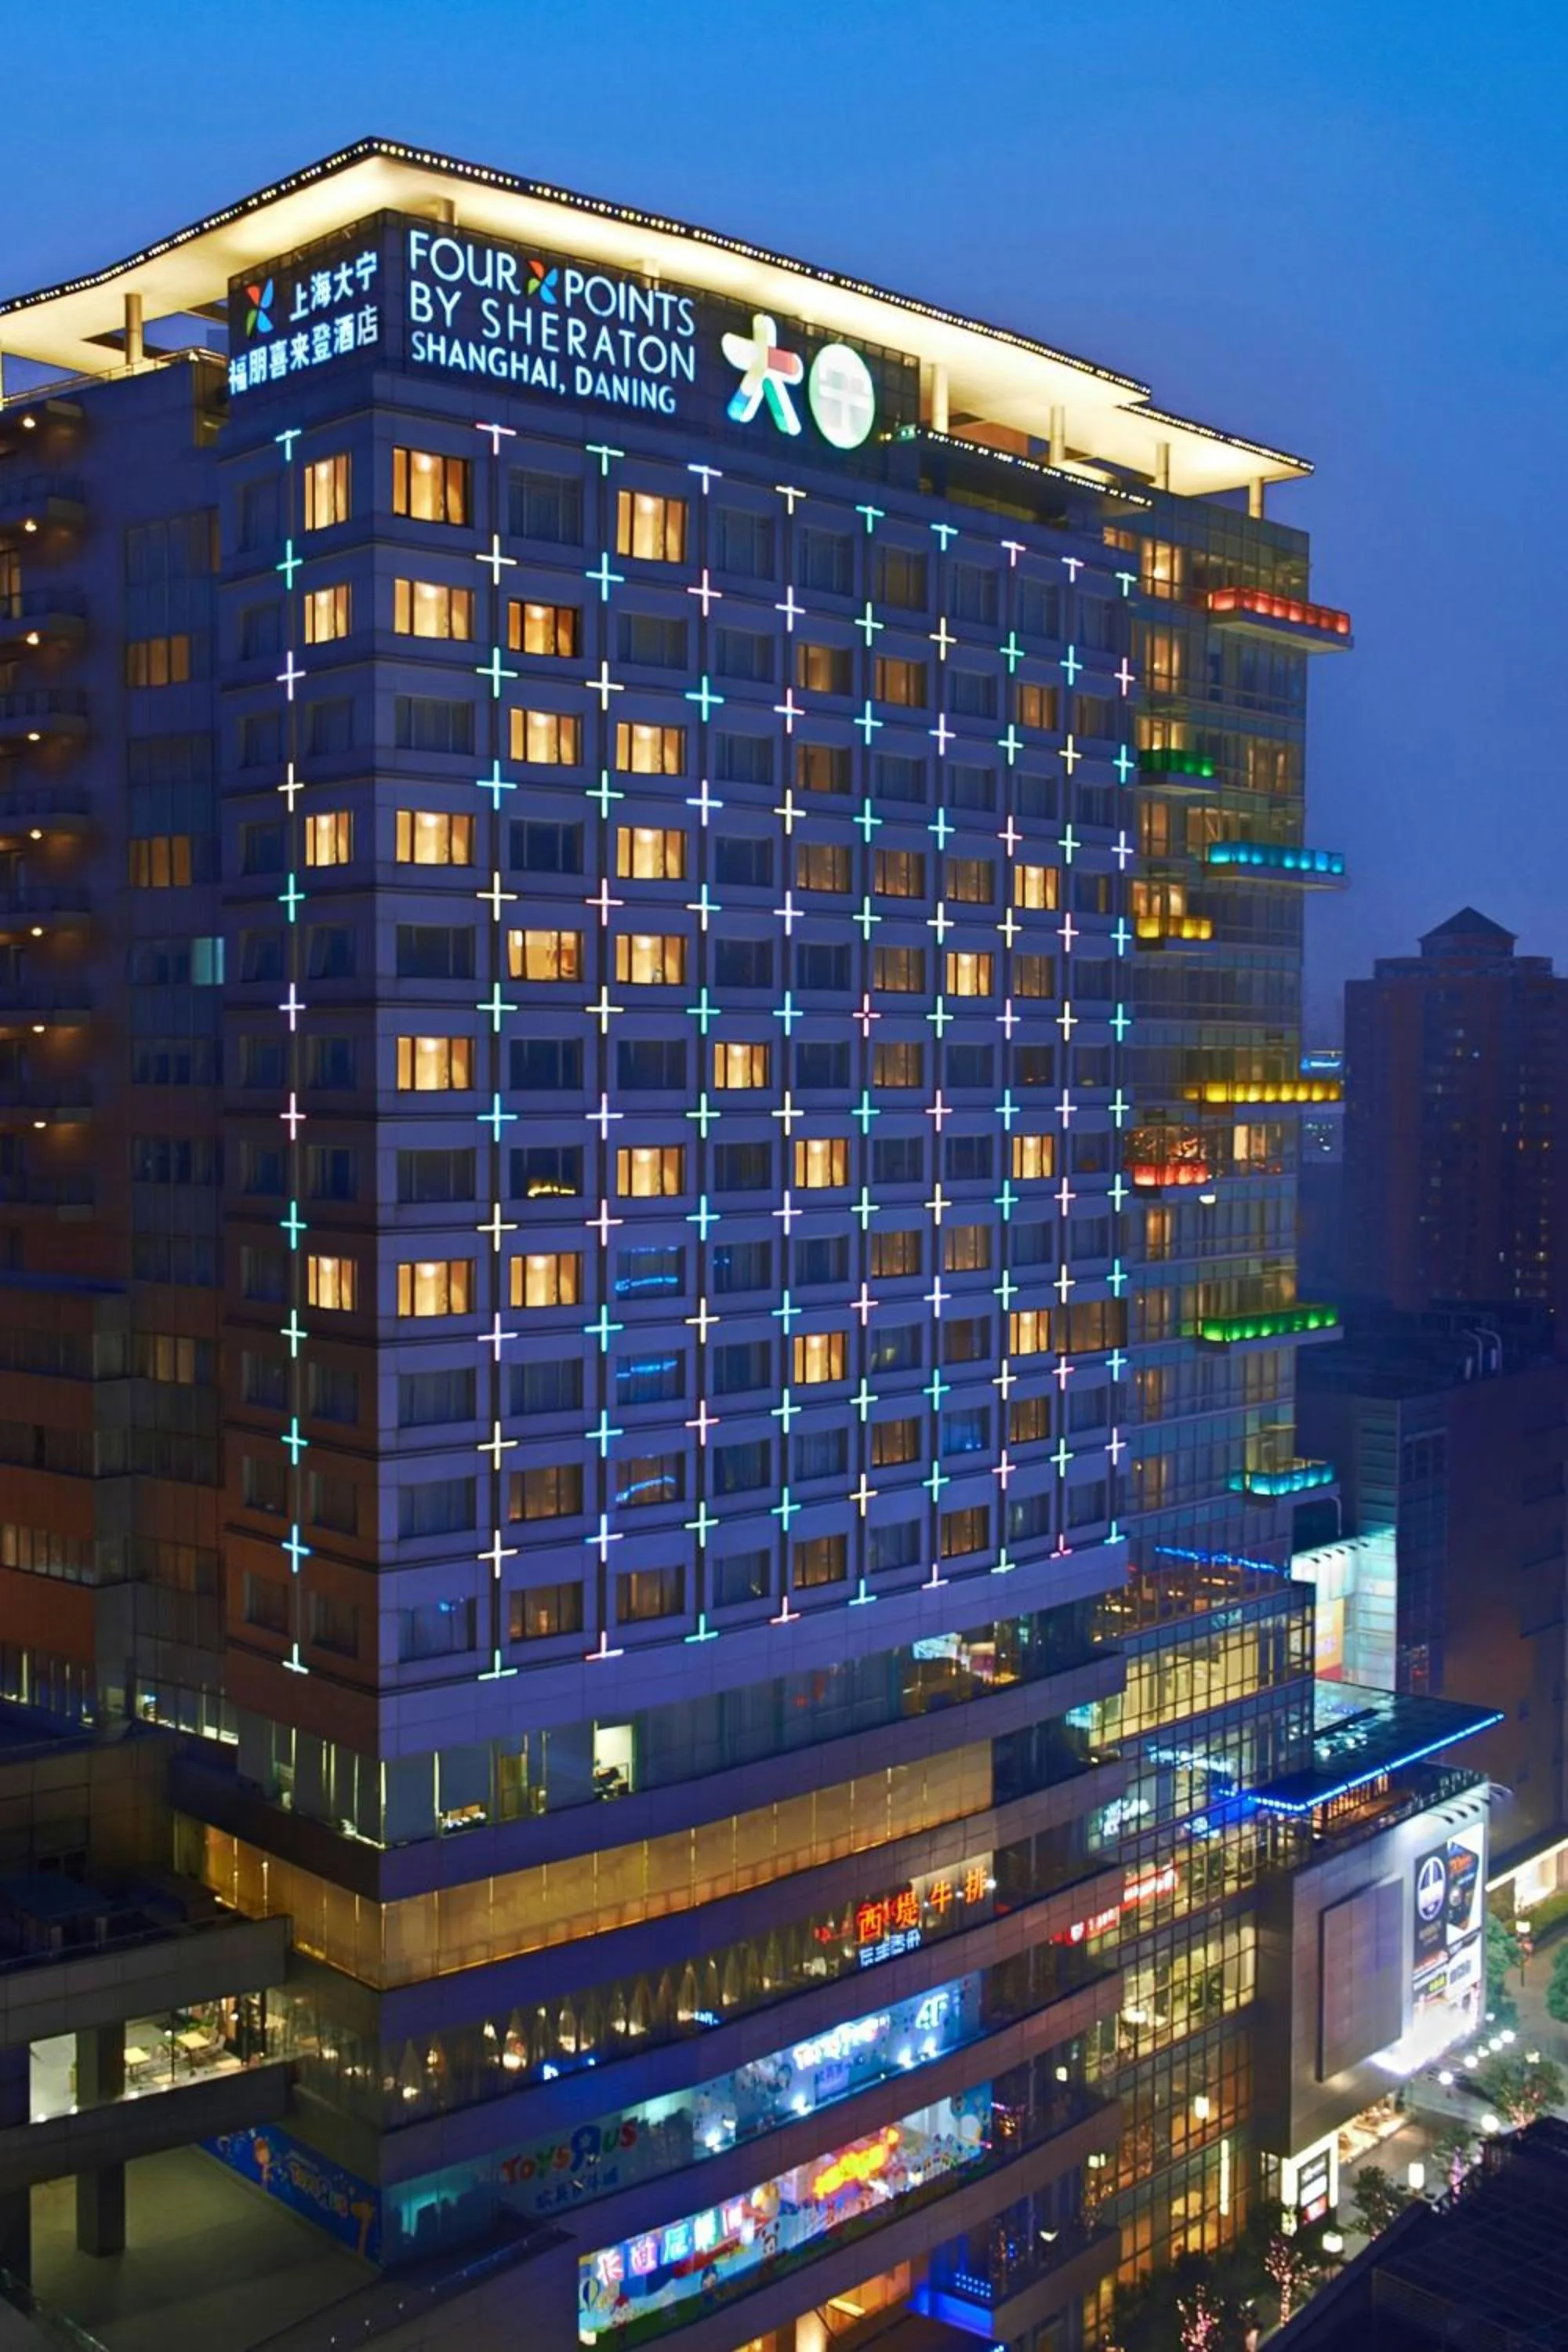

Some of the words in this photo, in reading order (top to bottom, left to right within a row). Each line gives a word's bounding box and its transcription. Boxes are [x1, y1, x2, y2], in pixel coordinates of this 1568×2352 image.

[289, 250, 378, 322] 上海大宁
[409, 230, 521, 296] FOUR
[564, 268, 695, 337] POINTS
[228, 303, 379, 395] 福朋喜来登酒店
[410, 280, 462, 328] BY
[481, 298, 695, 383] SHERATON
[411, 331, 566, 395] SHANGHAI,
[575, 365, 677, 414] DANING
